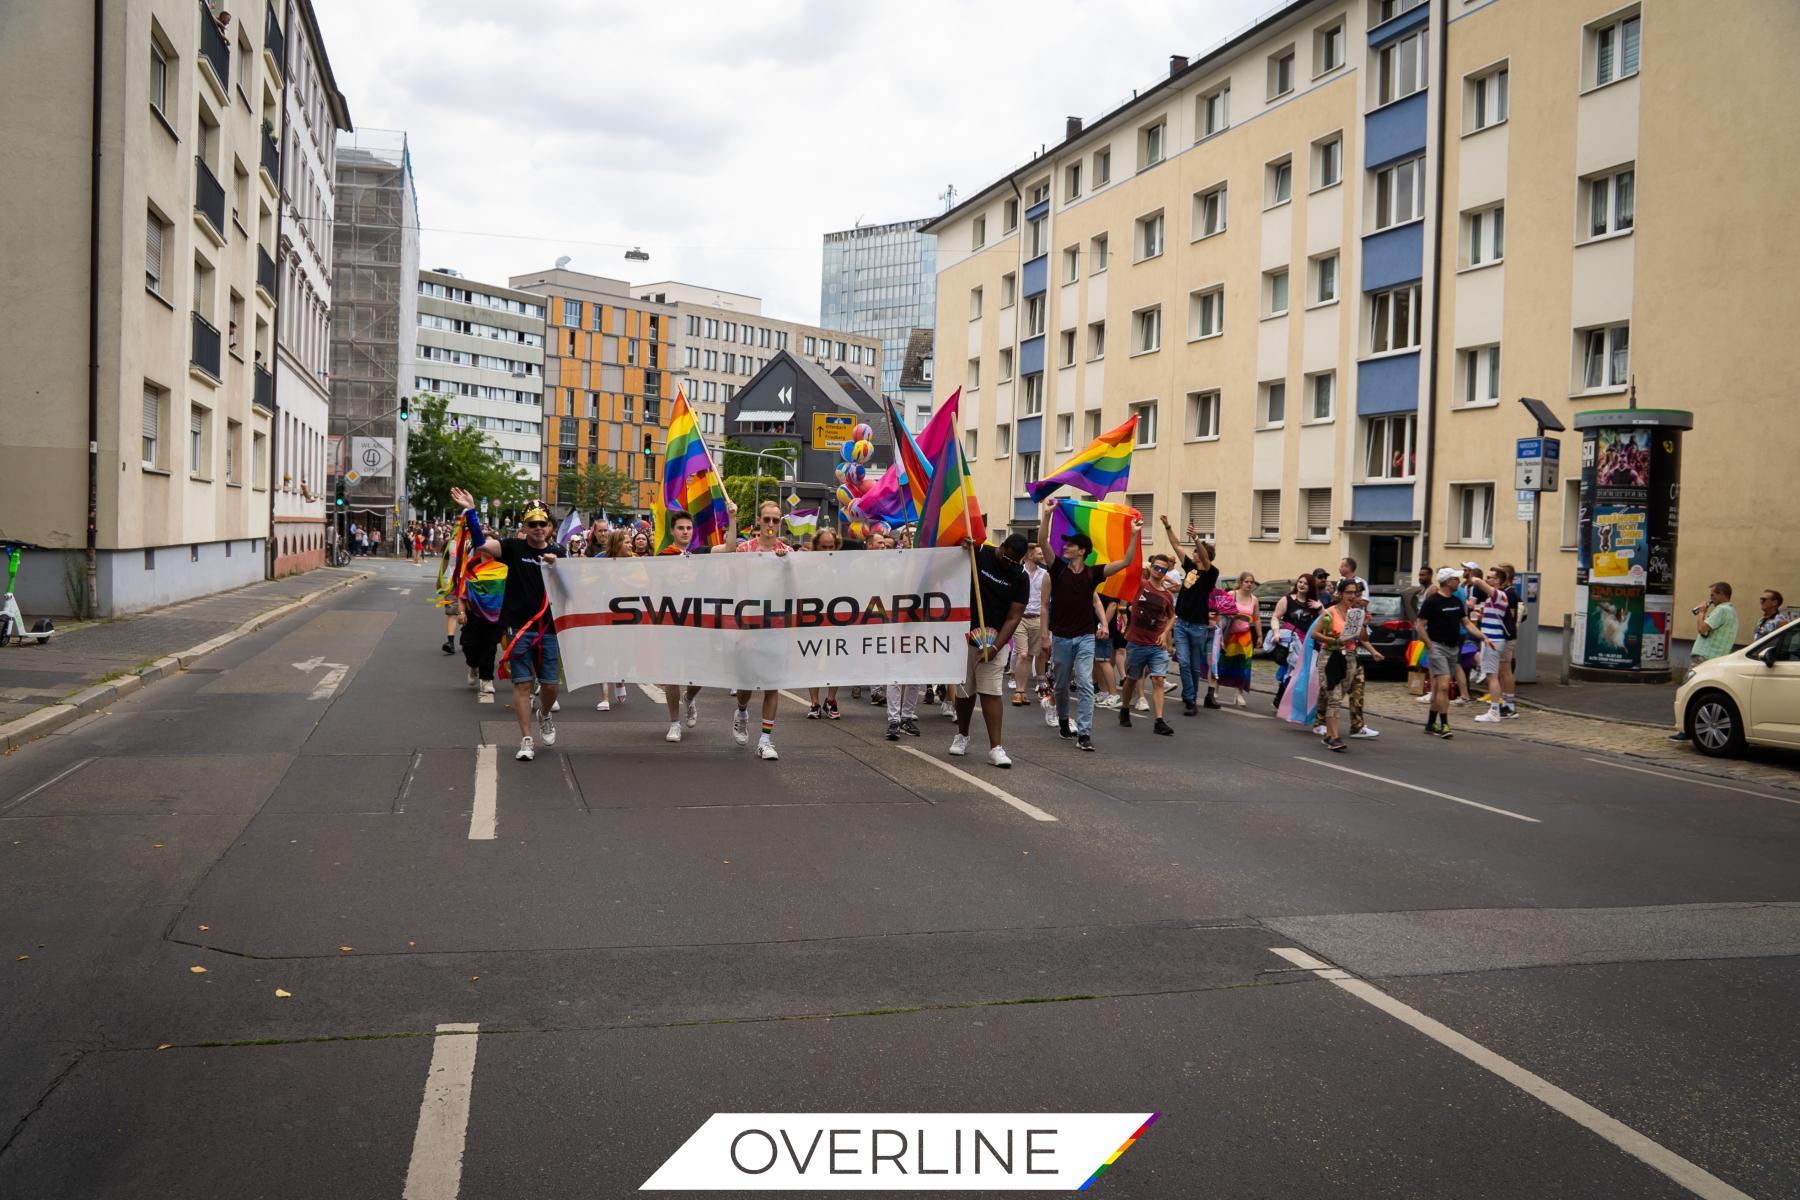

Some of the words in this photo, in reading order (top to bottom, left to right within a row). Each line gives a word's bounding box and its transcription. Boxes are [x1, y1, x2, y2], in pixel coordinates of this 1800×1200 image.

[608, 592, 951, 629] SWITCHBOARD
[797, 638, 849, 657] WIR
[862, 635, 950, 655] FEIERN
